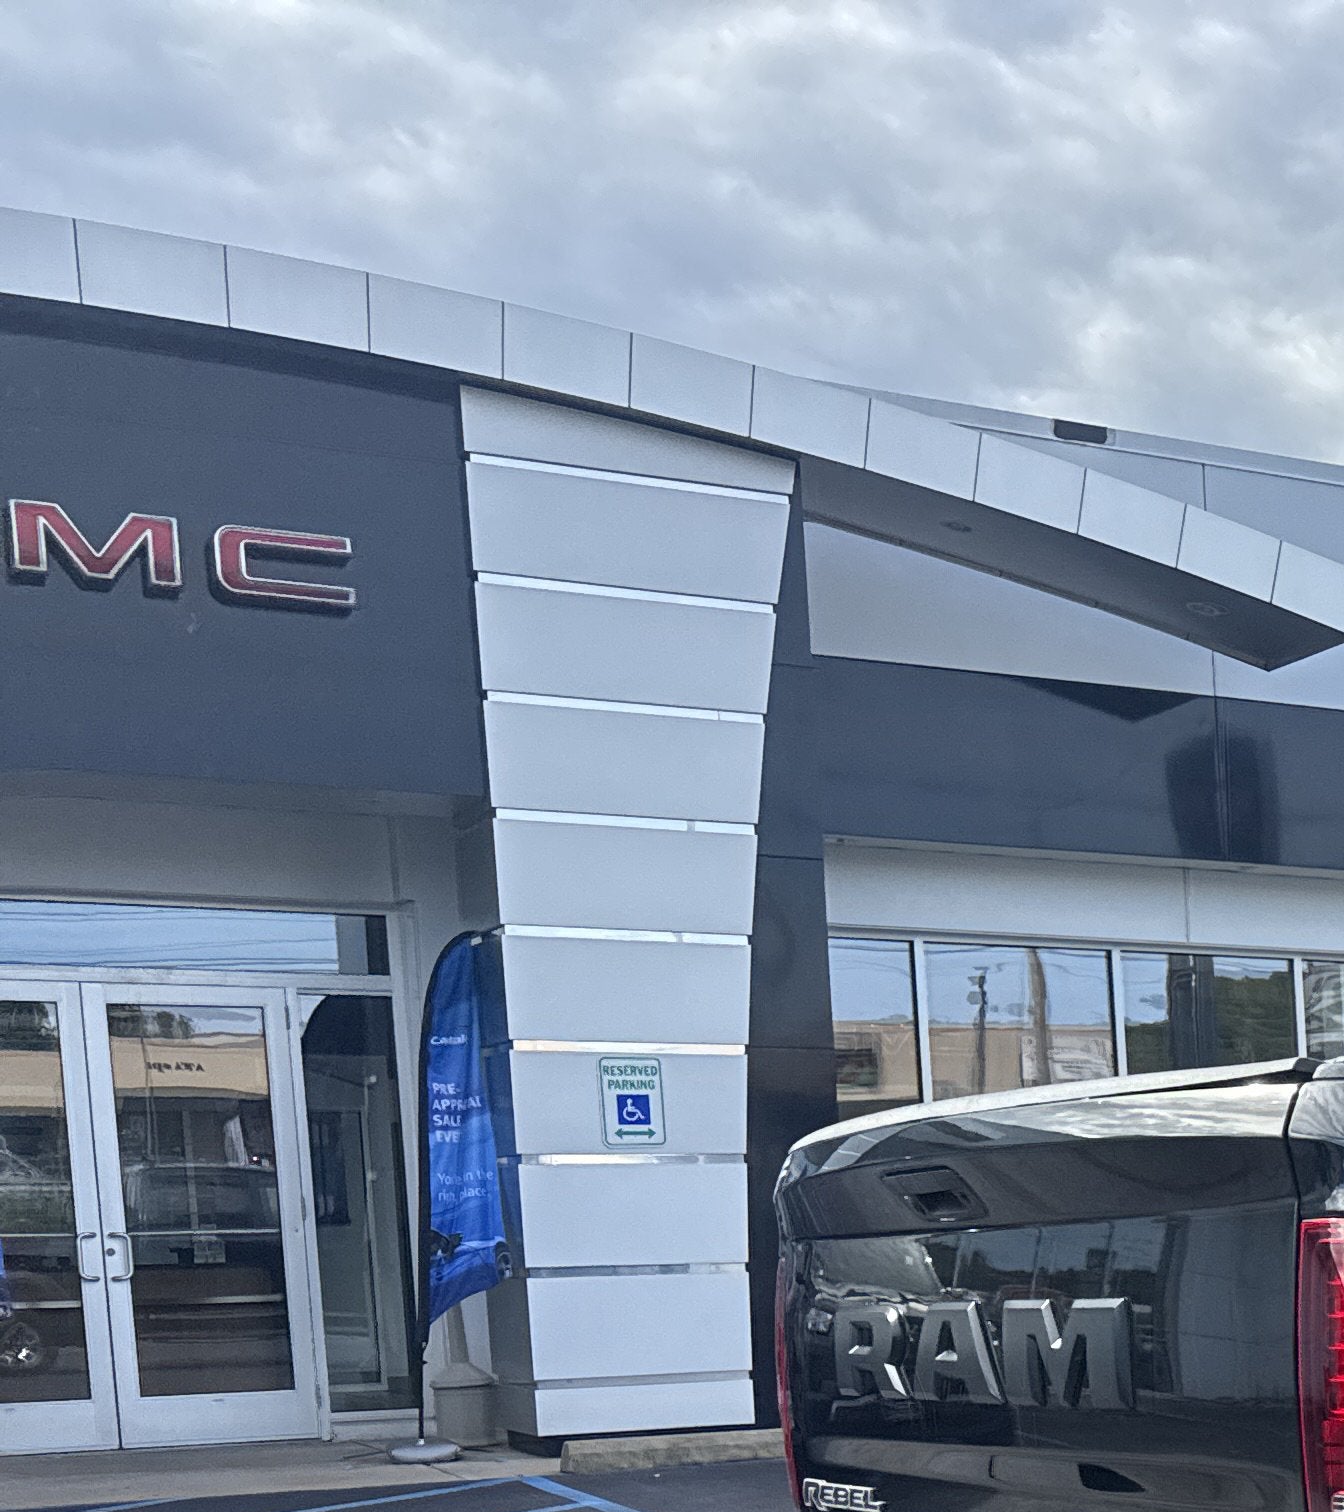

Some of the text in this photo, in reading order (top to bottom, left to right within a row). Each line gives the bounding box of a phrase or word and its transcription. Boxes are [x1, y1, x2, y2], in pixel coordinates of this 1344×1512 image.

[8, 498, 356, 604] MC
[602, 1065, 658, 1077] RESERVED
[607, 1079, 656, 1090] PARKING
[834, 1297, 1134, 1408] RAM
